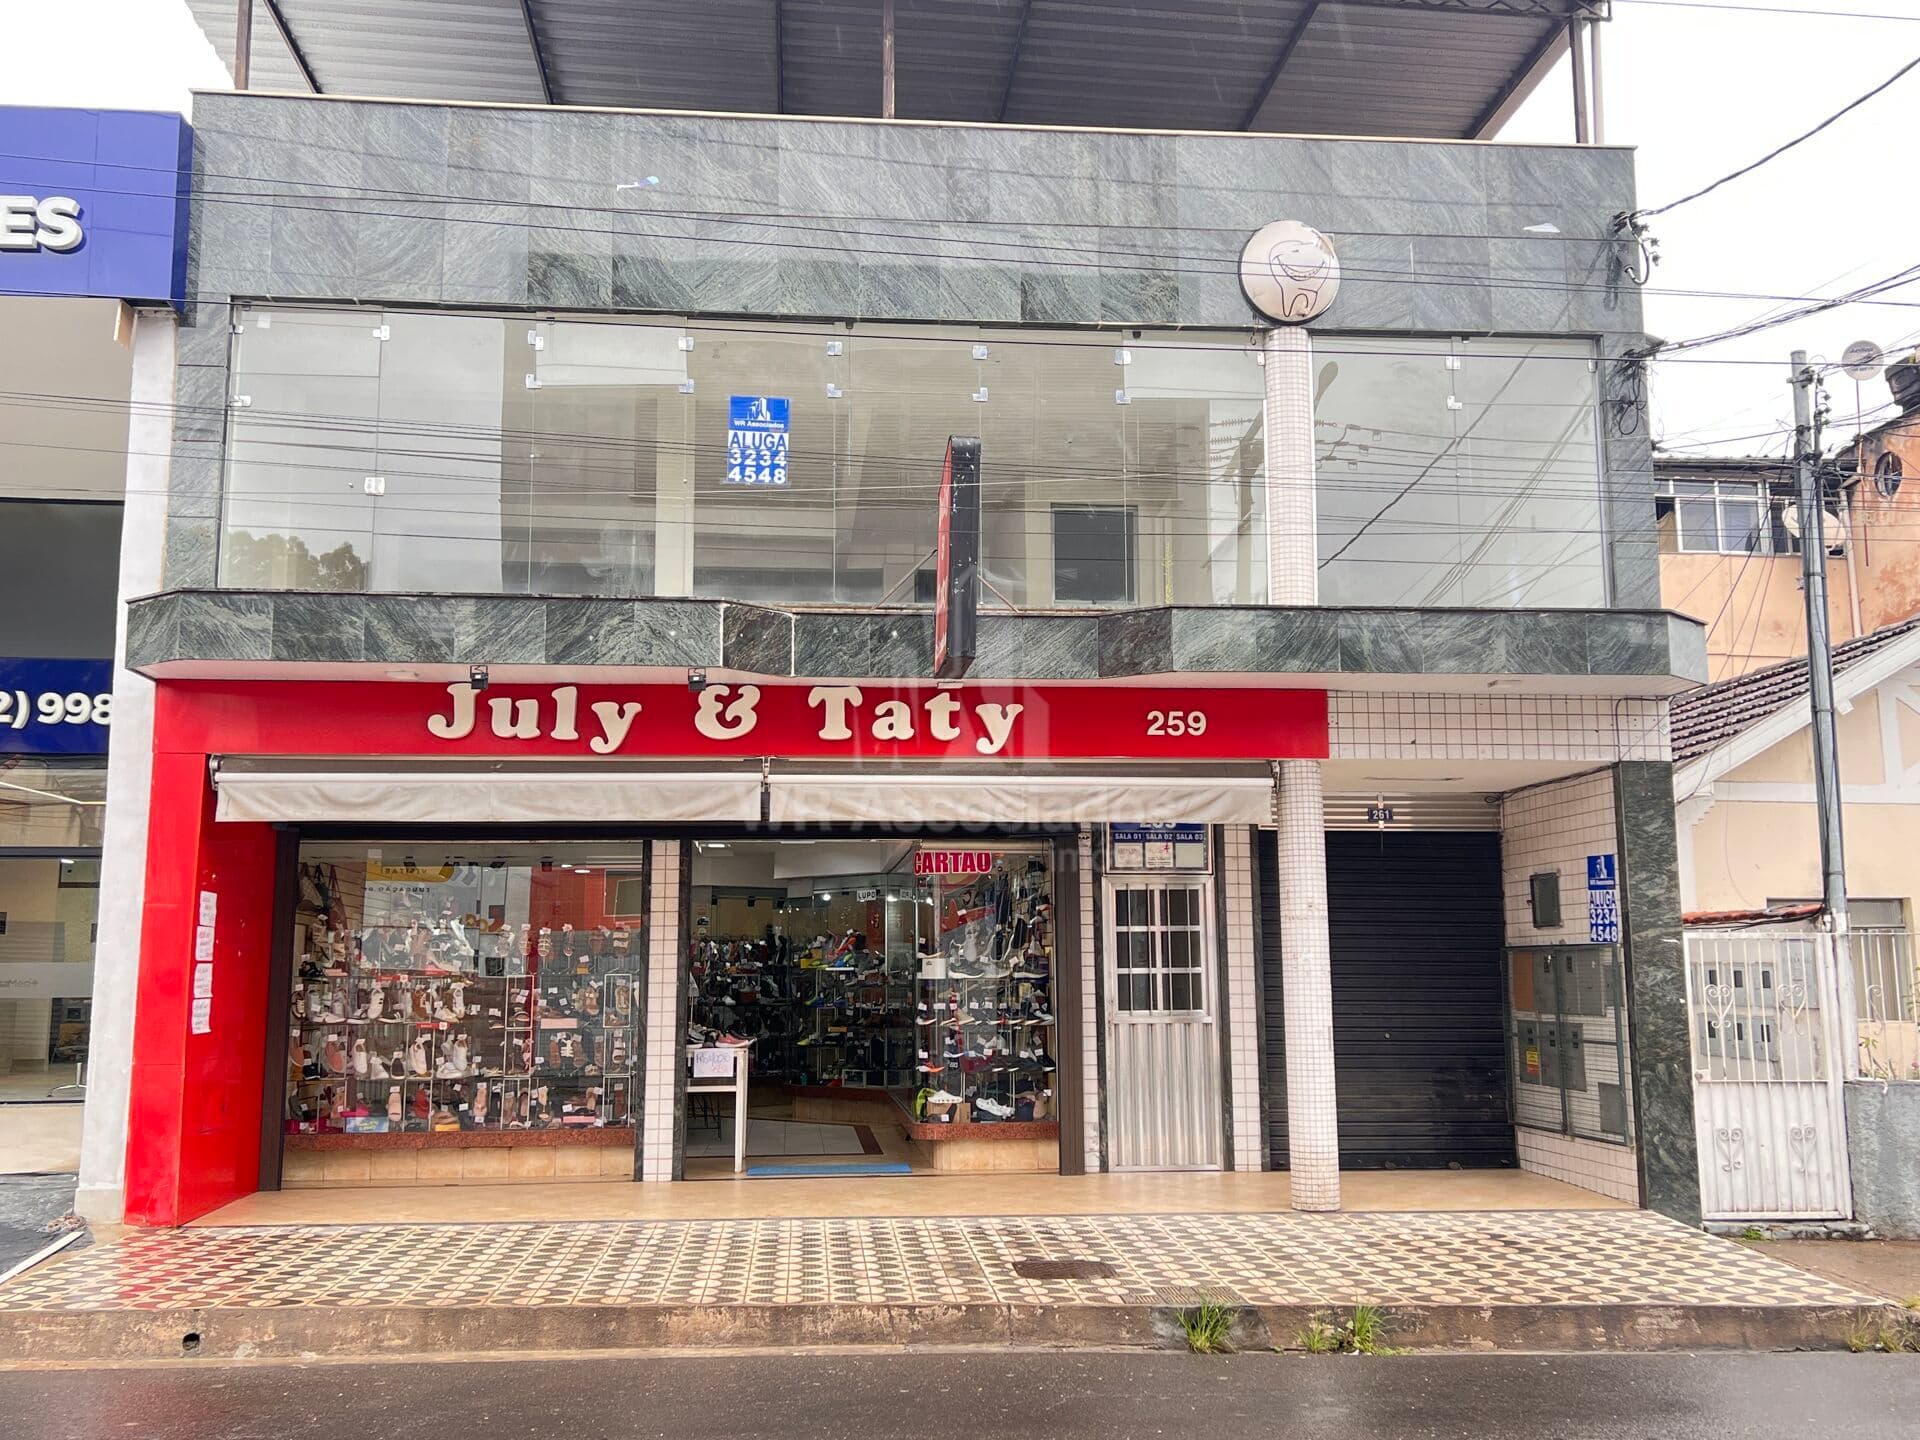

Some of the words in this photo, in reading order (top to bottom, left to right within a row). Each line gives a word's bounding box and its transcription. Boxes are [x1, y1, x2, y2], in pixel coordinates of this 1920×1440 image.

[730, 432, 787, 450] ALUGA
[729, 449, 787, 467] 3234
[728, 466, 786, 484] 4548
[427, 683, 642, 754] July
[694, 685, 761, 740] &
[808, 686, 1024, 754] Taty
[1146, 710, 1207, 736] 259
[1372, 810, 1390, 820] 261
[1589, 891, 1616, 908] ALUGA
[1590, 909, 1617, 925] 3234
[1590, 926, 1618, 942] 4548
